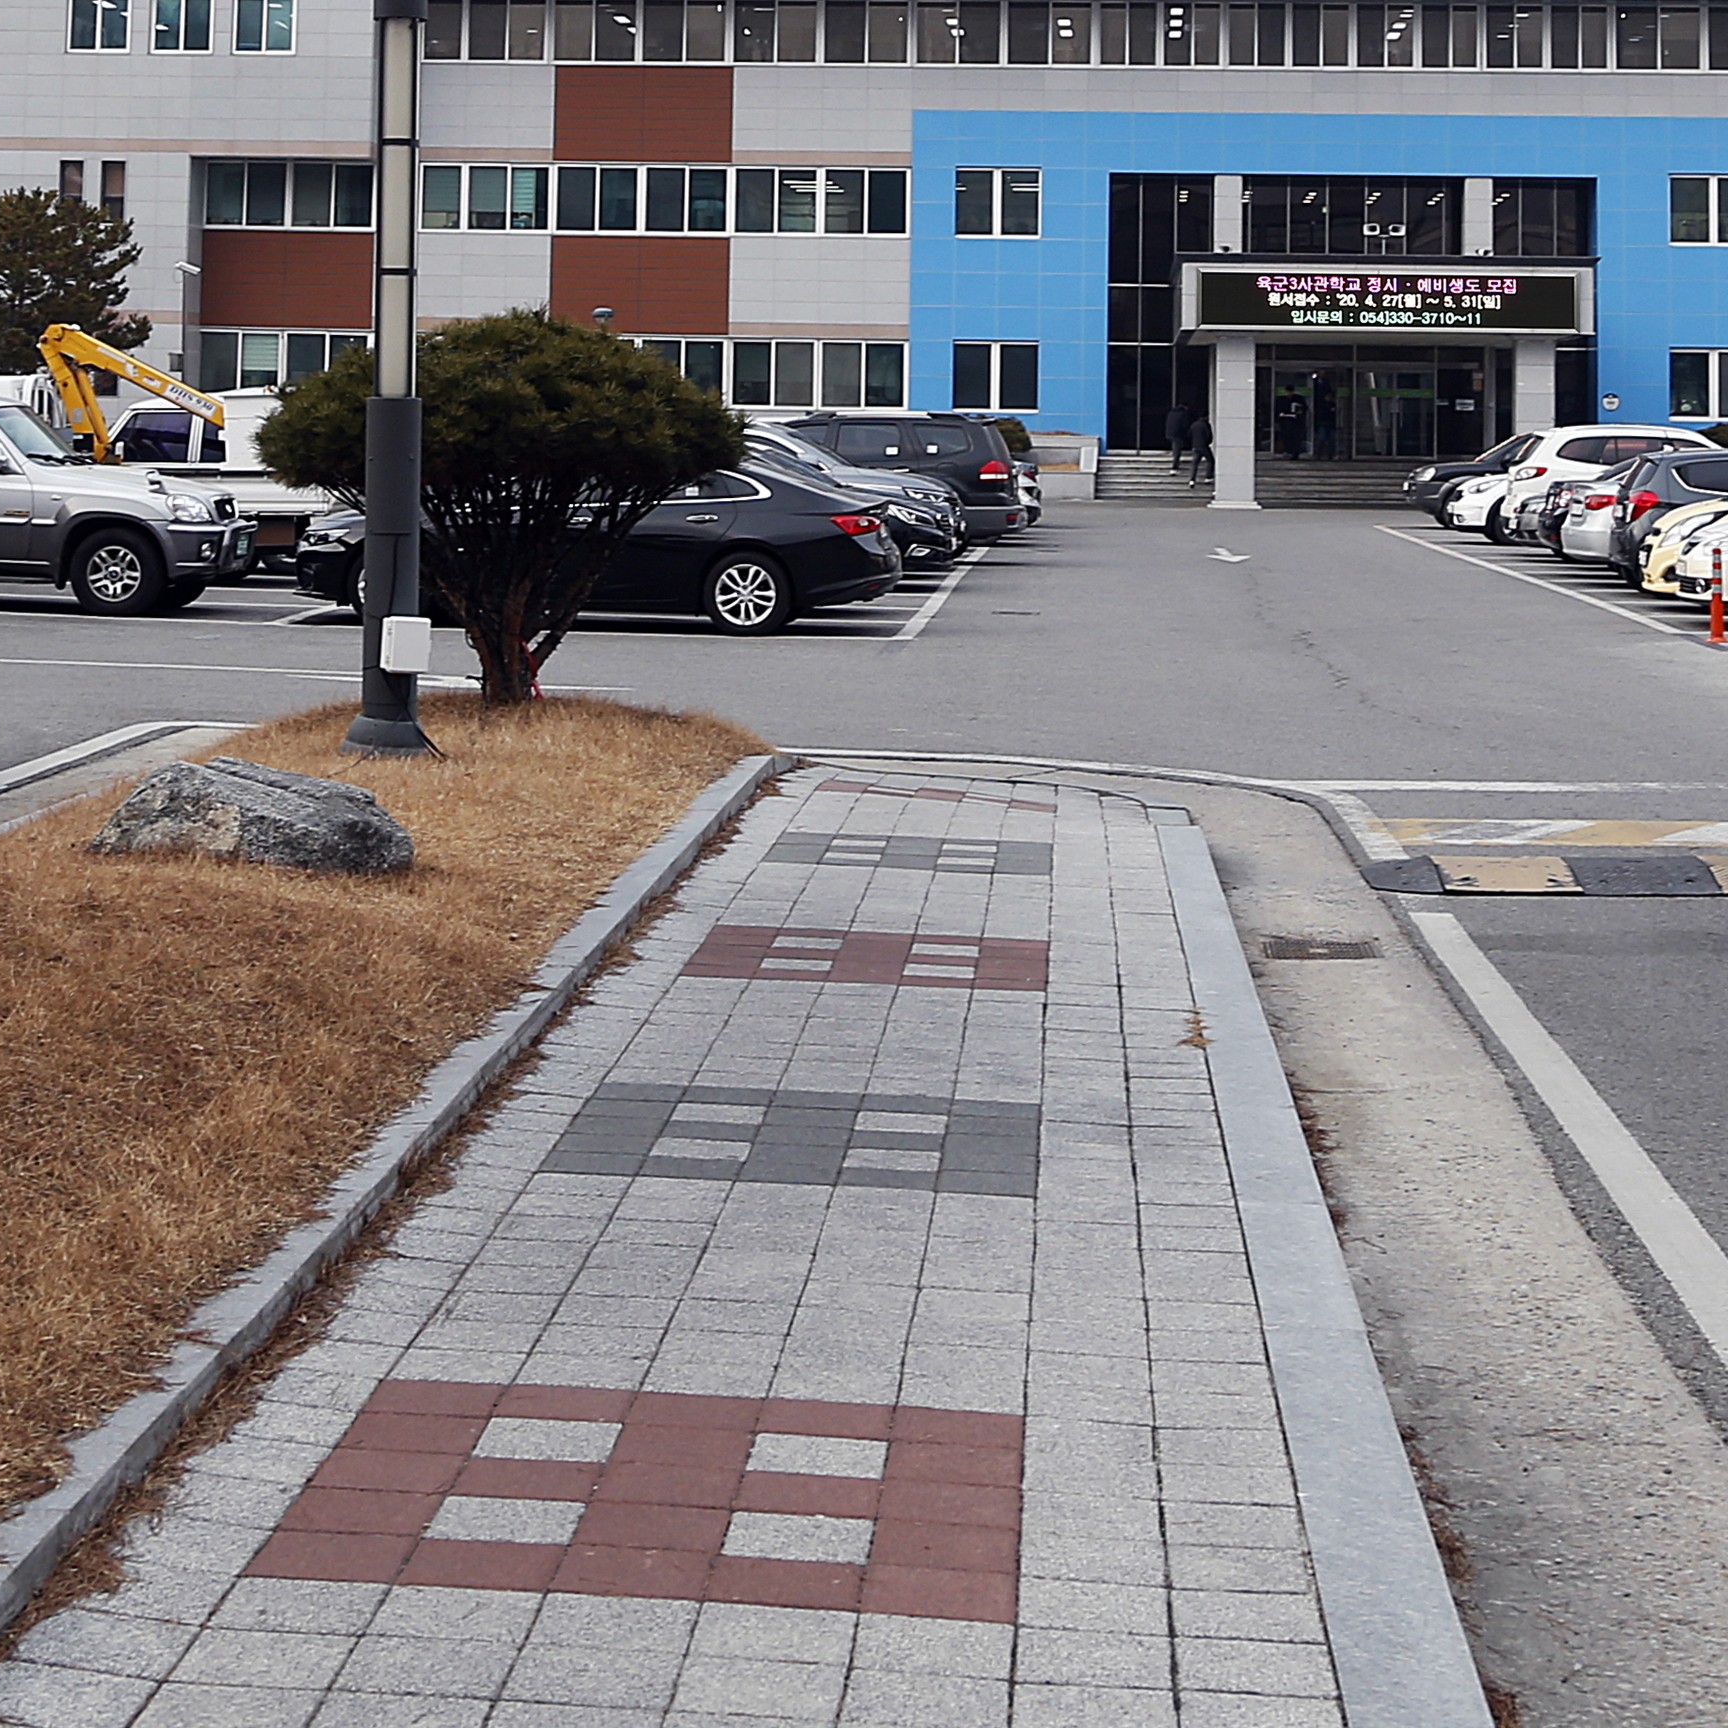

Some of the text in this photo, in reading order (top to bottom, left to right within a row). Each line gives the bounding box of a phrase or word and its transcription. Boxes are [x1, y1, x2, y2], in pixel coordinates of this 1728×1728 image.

[1256, 276, 1362, 292] 육군3사관학교
[1367, 277, 1398, 293] 정시
[1417, 278, 1481, 294] 예비생도
[1486, 278, 1517, 294] 모집
[1267, 292, 1320, 307] 원서접수
[1291, 310, 1343, 324] 입시문의
